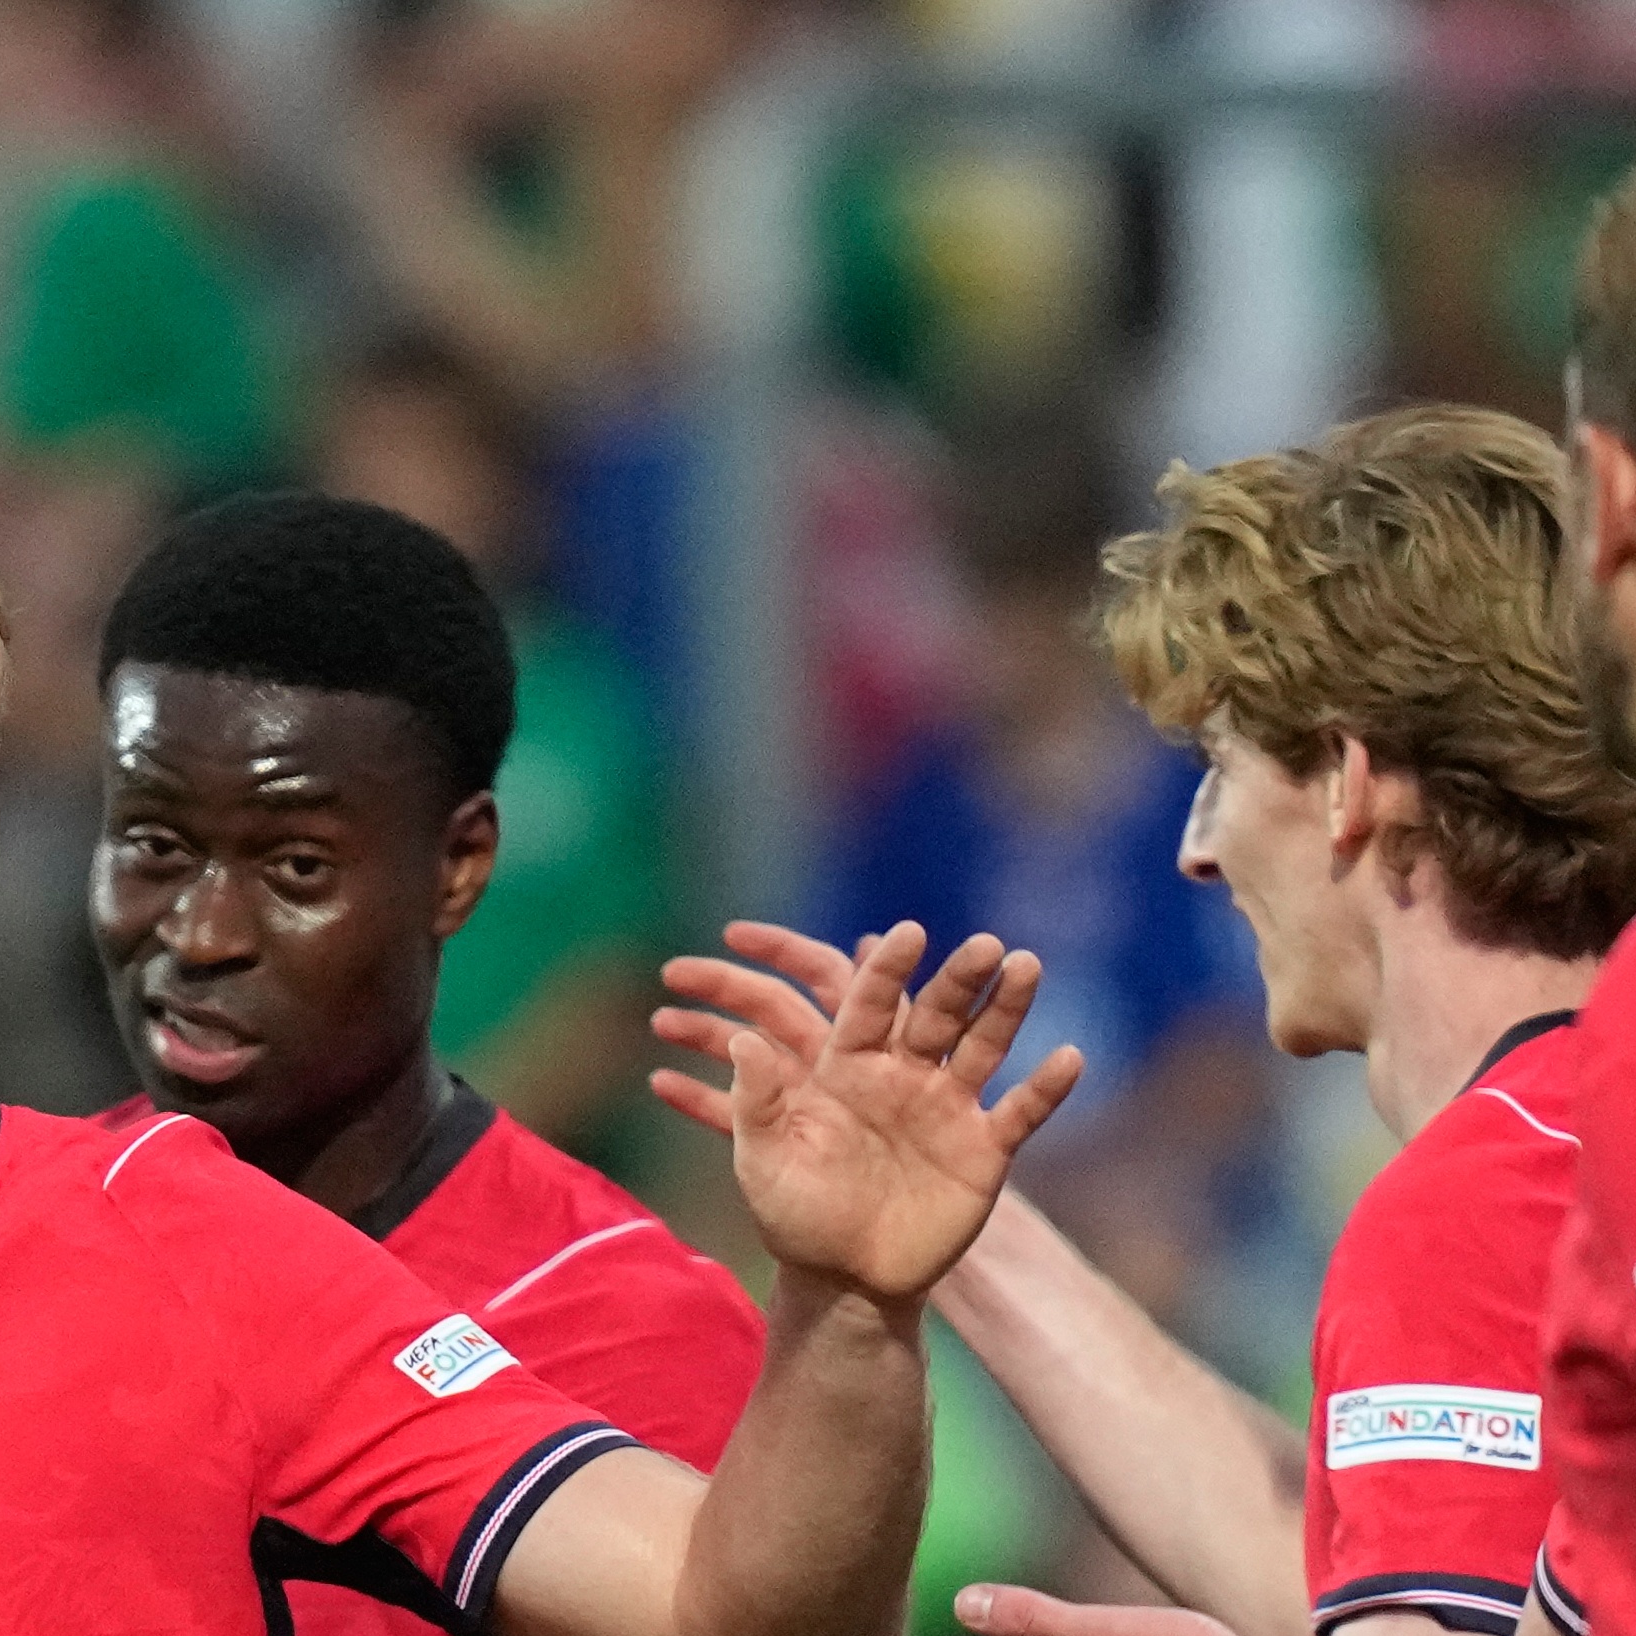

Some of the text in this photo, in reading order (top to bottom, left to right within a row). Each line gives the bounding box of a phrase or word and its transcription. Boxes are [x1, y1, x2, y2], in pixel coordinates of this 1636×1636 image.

[403, 1336, 442, 1369] UEFA
[415, 1329, 495, 1385] FOUN
[1334, 1409, 1536, 1443] FOUNDATION
